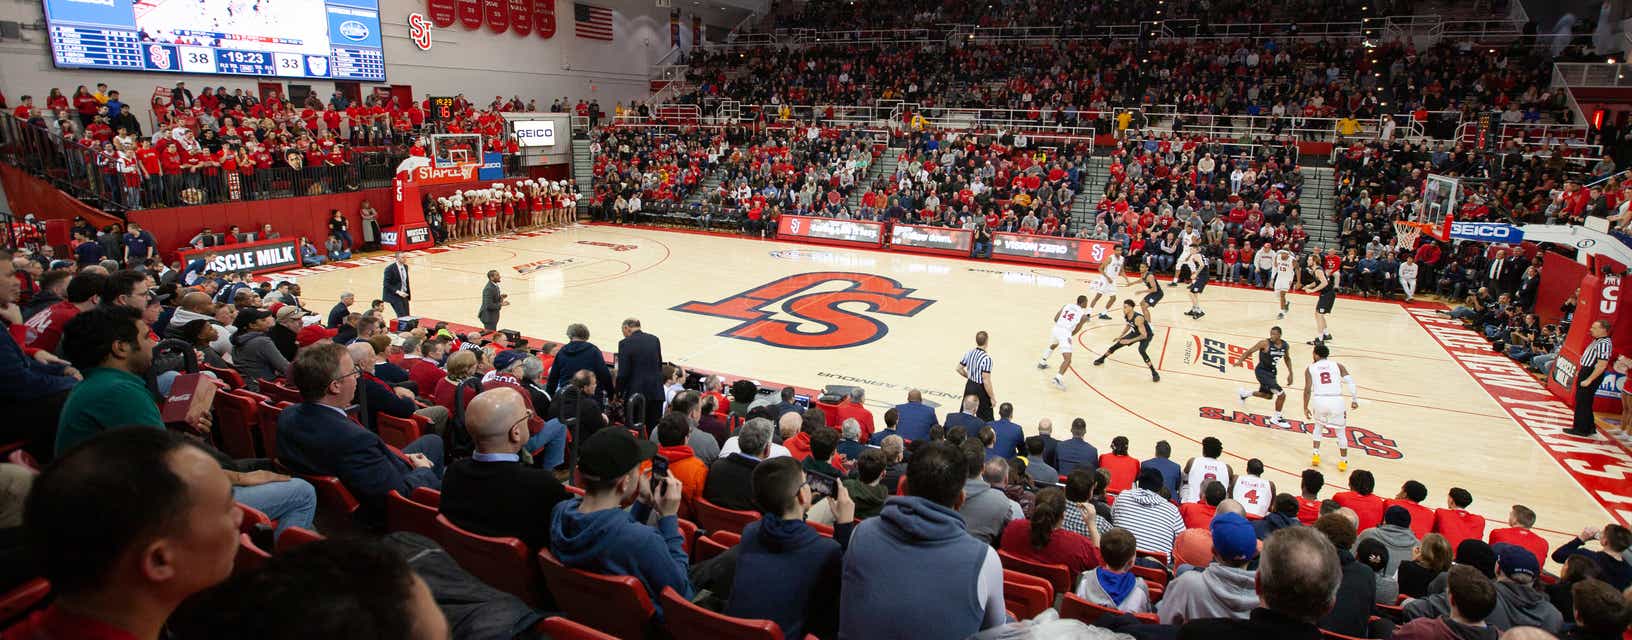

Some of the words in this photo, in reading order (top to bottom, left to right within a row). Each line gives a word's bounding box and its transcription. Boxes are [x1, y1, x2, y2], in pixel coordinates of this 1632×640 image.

[188, 52, 209, 64] 38
[228, 51, 264, 64] 19:23
[281, 58, 299, 69] 33
[517, 128, 553, 138] GEICO
[1450, 222, 1510, 238] GEICO
[256, 246, 295, 266] MILK
[1202, 337, 1226, 373] EAST
[1244, 489, 1259, 505] 4
